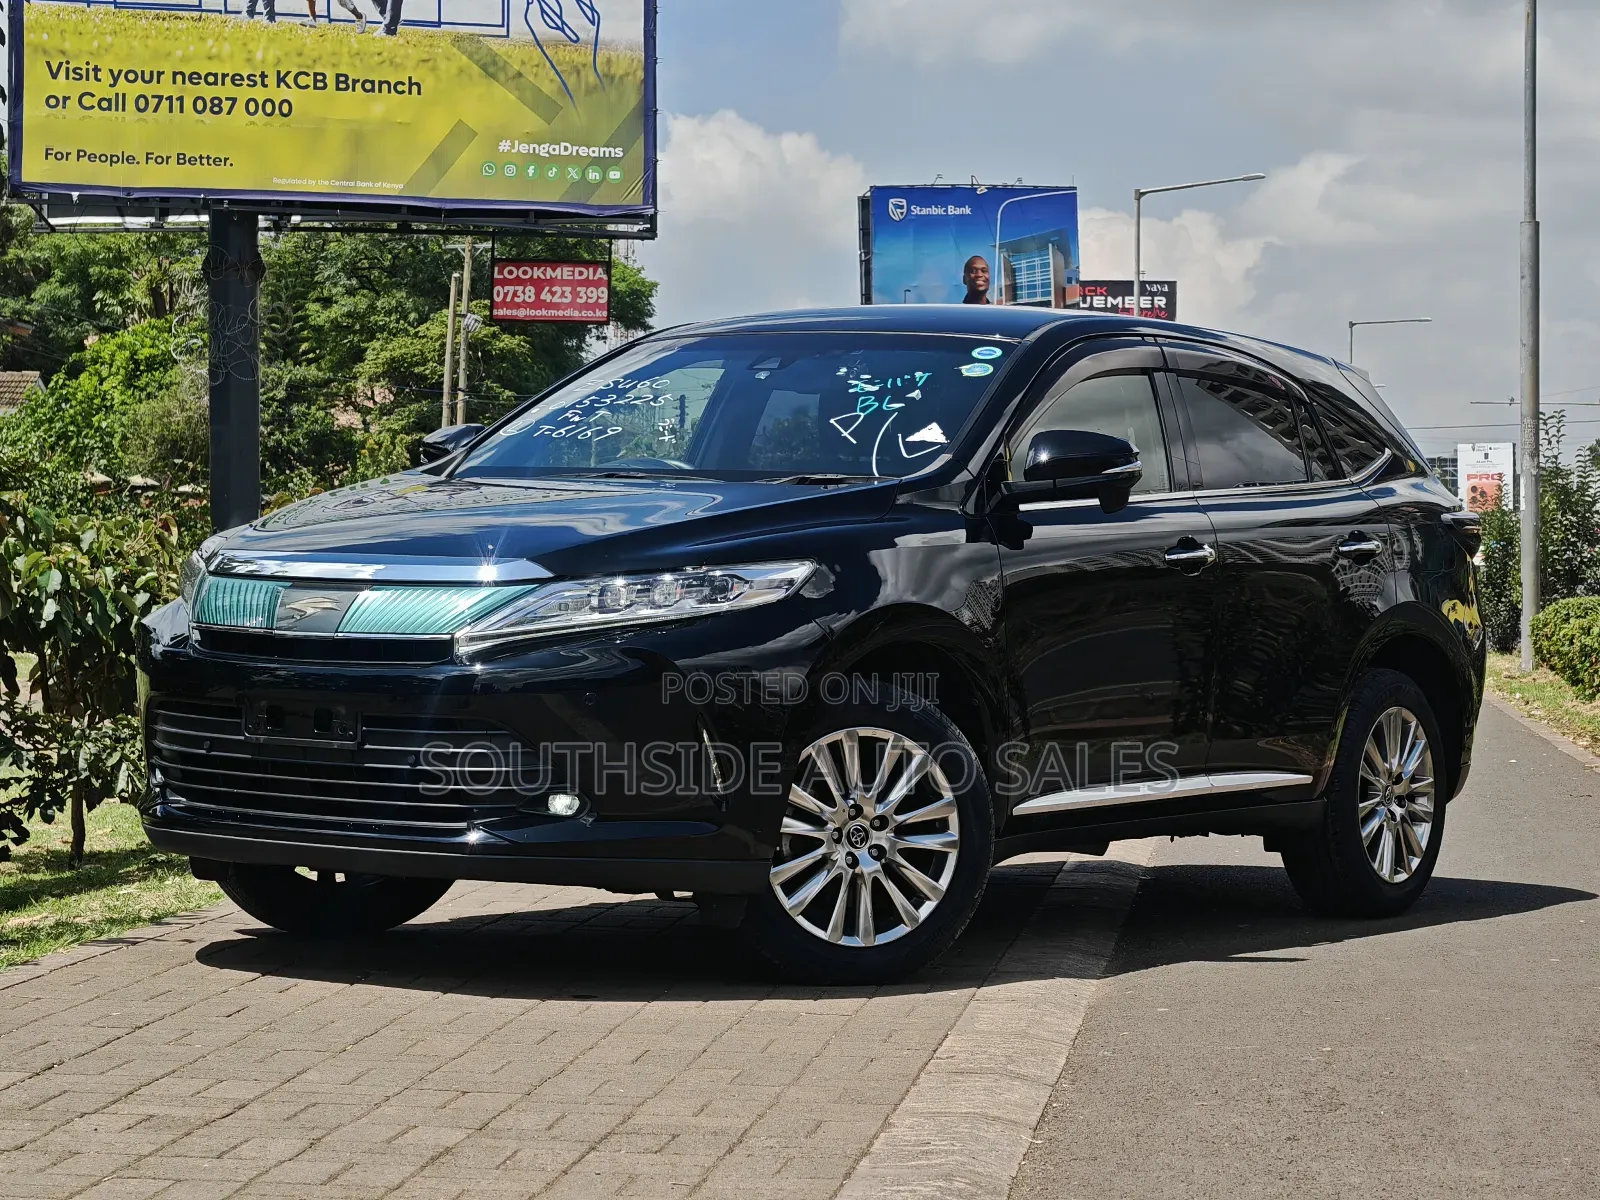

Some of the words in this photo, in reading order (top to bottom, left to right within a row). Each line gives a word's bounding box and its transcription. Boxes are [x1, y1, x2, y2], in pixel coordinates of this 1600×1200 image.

[45, 60, 102, 82] Visit
[108, 68, 165, 88] your
[171, 70, 269, 88] nearest
[276, 70, 328, 91] KCB
[335, 73, 422, 96] Branch
[45, 94, 71, 110] or
[77, 91, 127, 112] Call
[134, 94, 185, 114] 0711
[192, 96, 238, 116] 087
[244, 98, 293, 118] 000
[44, 147, 72, 162] For
[76, 149, 140, 167] People.
[145, 152, 172, 166] For
[176, 152, 234, 168] Better.
[498, 139, 624, 159] #JengaDreams
[272, 176, 307, 186] Regulated
[307, 178, 317, 187] by
[330, 179, 356, 188] Central
[356, 180, 374, 188] Bank
[382, 182, 404, 190] Kenya
[910, 203, 948, 217] Stanbic
[948, 205, 972, 217] Bank
[493, 266, 608, 281] LOOKMEDIA
[493, 286, 536, 303] 0738
[540, 286, 572, 304] 423
[576, 286, 608, 304] 399
[492, 308, 608, 319] sales@lookmedia.co.ke
